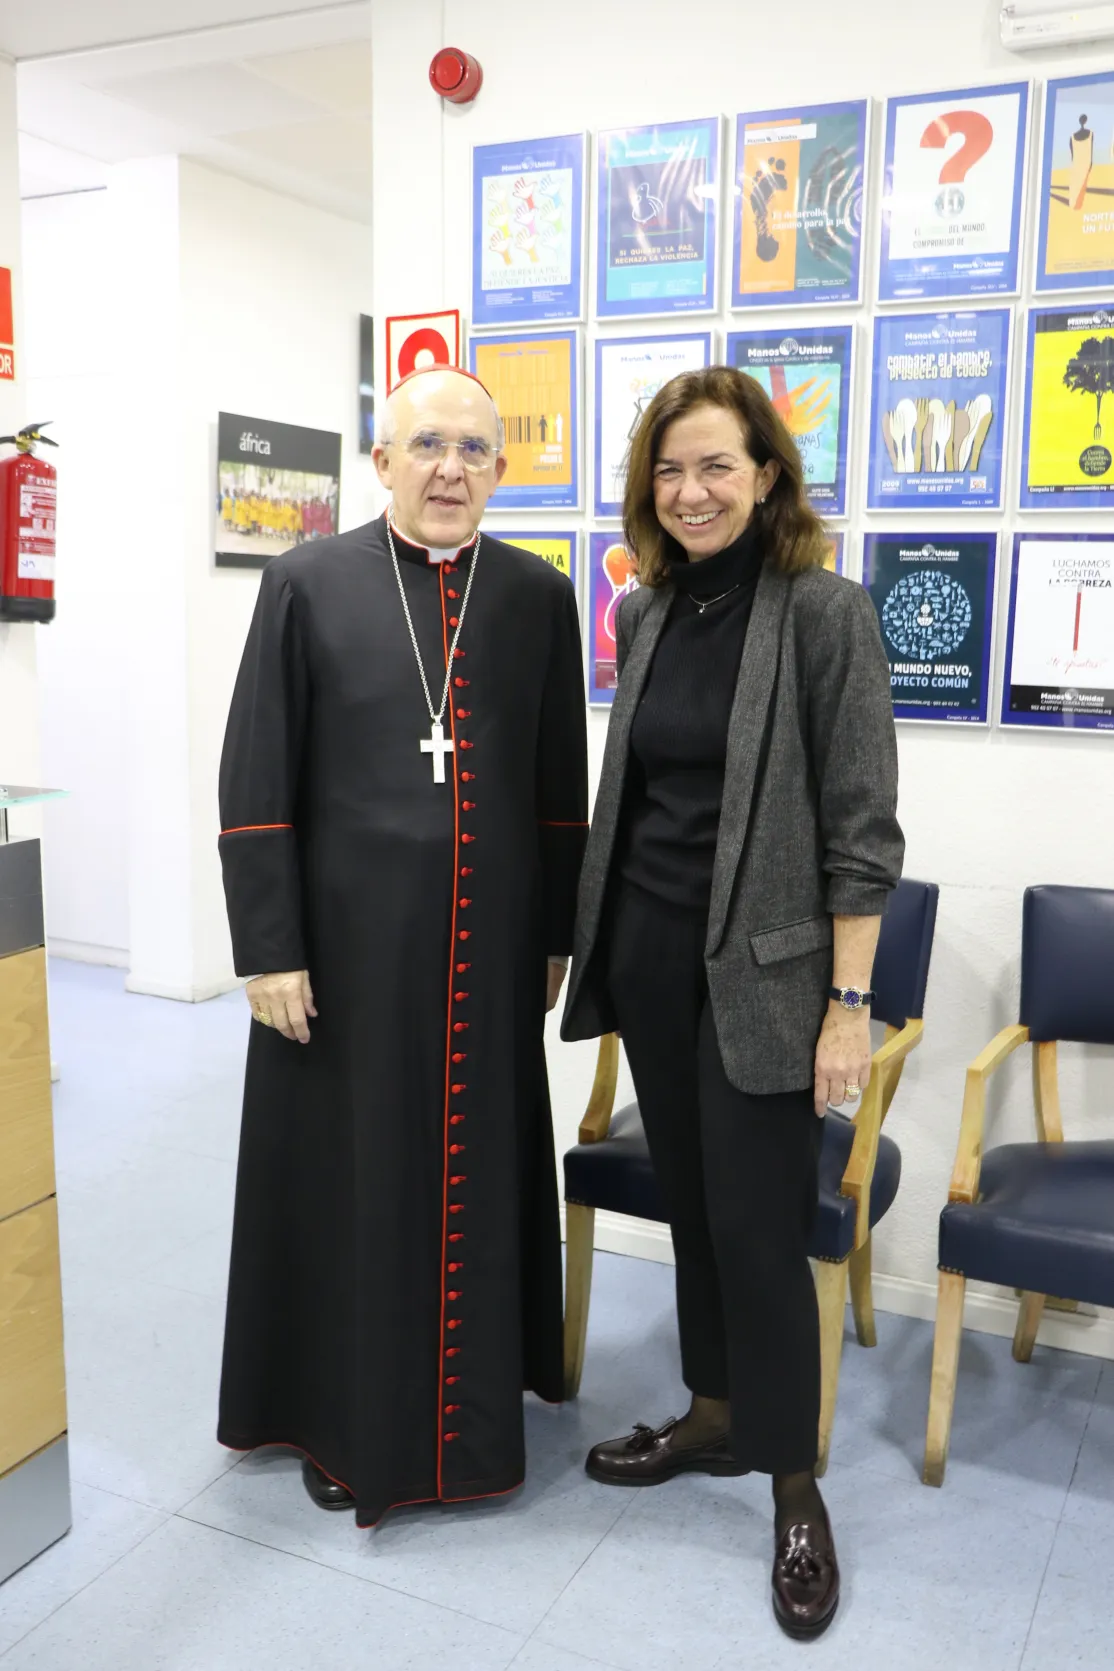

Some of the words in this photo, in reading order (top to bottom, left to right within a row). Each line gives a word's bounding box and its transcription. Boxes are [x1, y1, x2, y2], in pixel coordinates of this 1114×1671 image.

[803, 220, 824, 229] para
[948, 225, 960, 234] DEL
[1082, 224, 1096, 234] UN
[912, 238, 955, 249] COMPROMISO
[956, 237, 964, 246] DE
[615, 256, 647, 264] RECHAZA
[660, 252, 698, 261] VIOLENCIA
[904, 332, 932, 341] Manos
[947, 329, 977, 338] Unidas
[747, 348, 780, 358] Manos
[798, 345, 834, 355] Unidas
[887, 353, 935, 370] combatir
[938, 352, 947, 367] el
[950, 349, 993, 368] hambre,
[889, 366, 938, 381] proyecto
[939, 366, 953, 379] de
[955, 364, 989, 377] todos
[239, 432, 271, 455] áfrica
[899, 549, 922, 557] Manos
[935, 549, 960, 557] Unidas
[1052, 559, 1111, 568] LUCHAMOS
[1058, 569, 1101, 578] CONTRA
[893, 663, 932, 675] MUNDO
[933, 664, 972, 677] NUEVO,
[931, 676, 969, 688] COMÚN
[1040, 692, 1064, 700] Manos
[1078, 694, 1105, 702] Unidas
